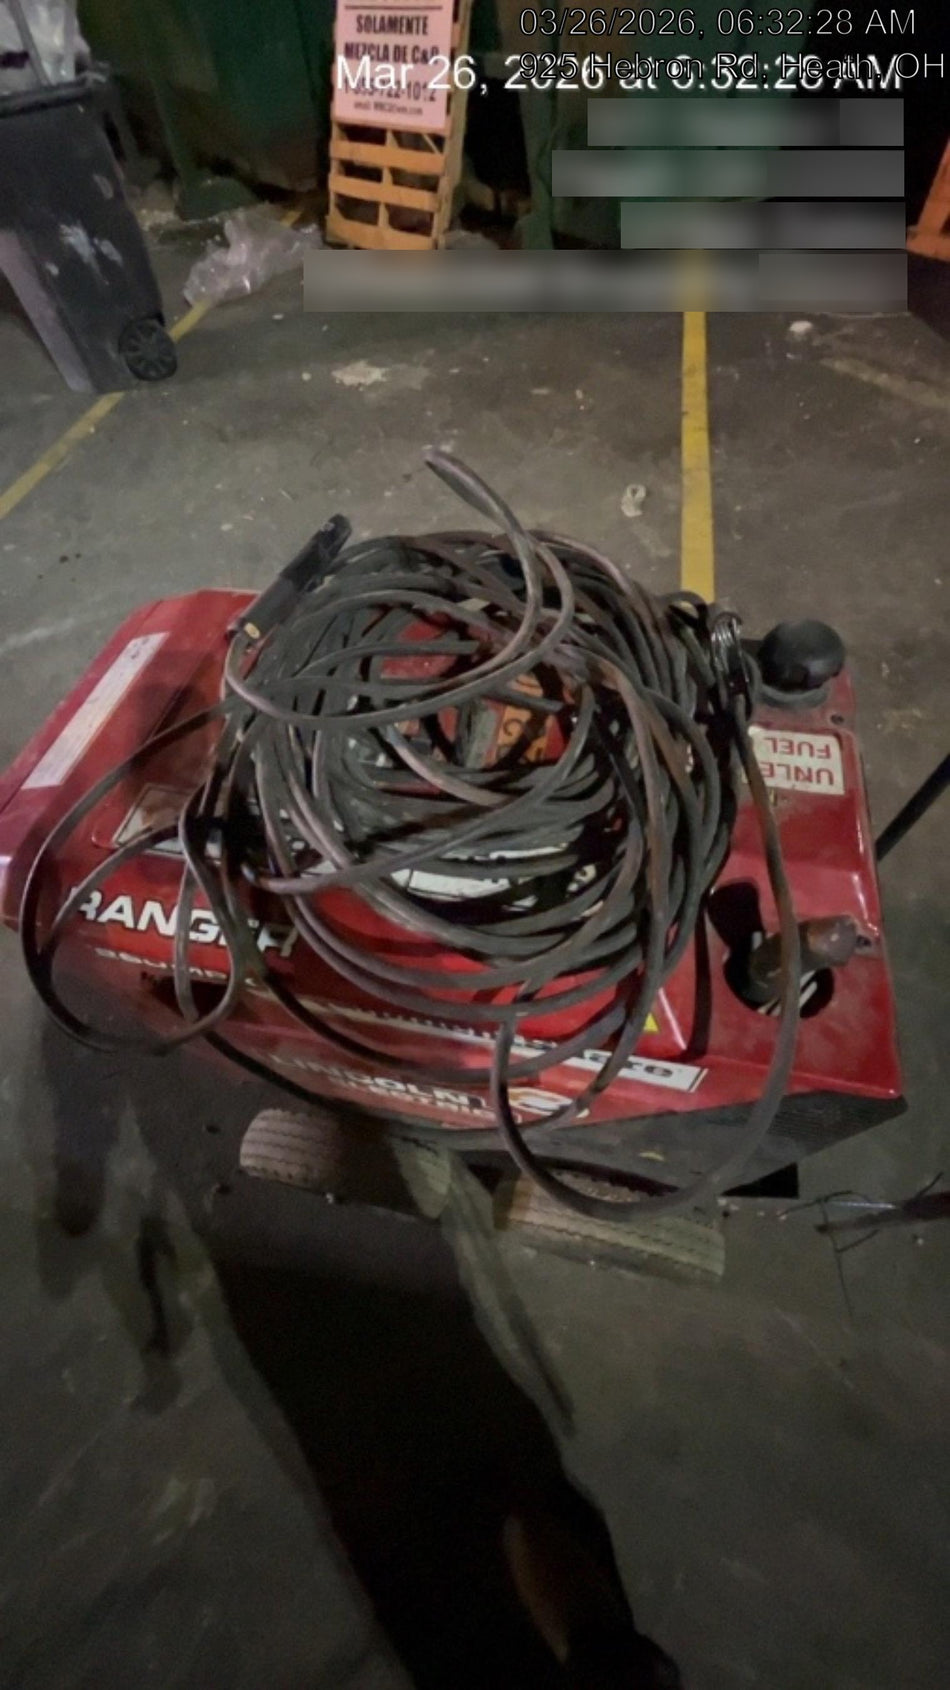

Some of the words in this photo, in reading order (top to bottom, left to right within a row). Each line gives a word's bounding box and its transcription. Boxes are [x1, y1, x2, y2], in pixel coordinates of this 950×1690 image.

[356, 14, 429, 36] SOLAMENTE
[393, 44, 409, 64] DE
[764, 737, 831, 759] FUEL
[760, 761, 834, 786] UNLE
[70, 886, 299, 957] RANGR
